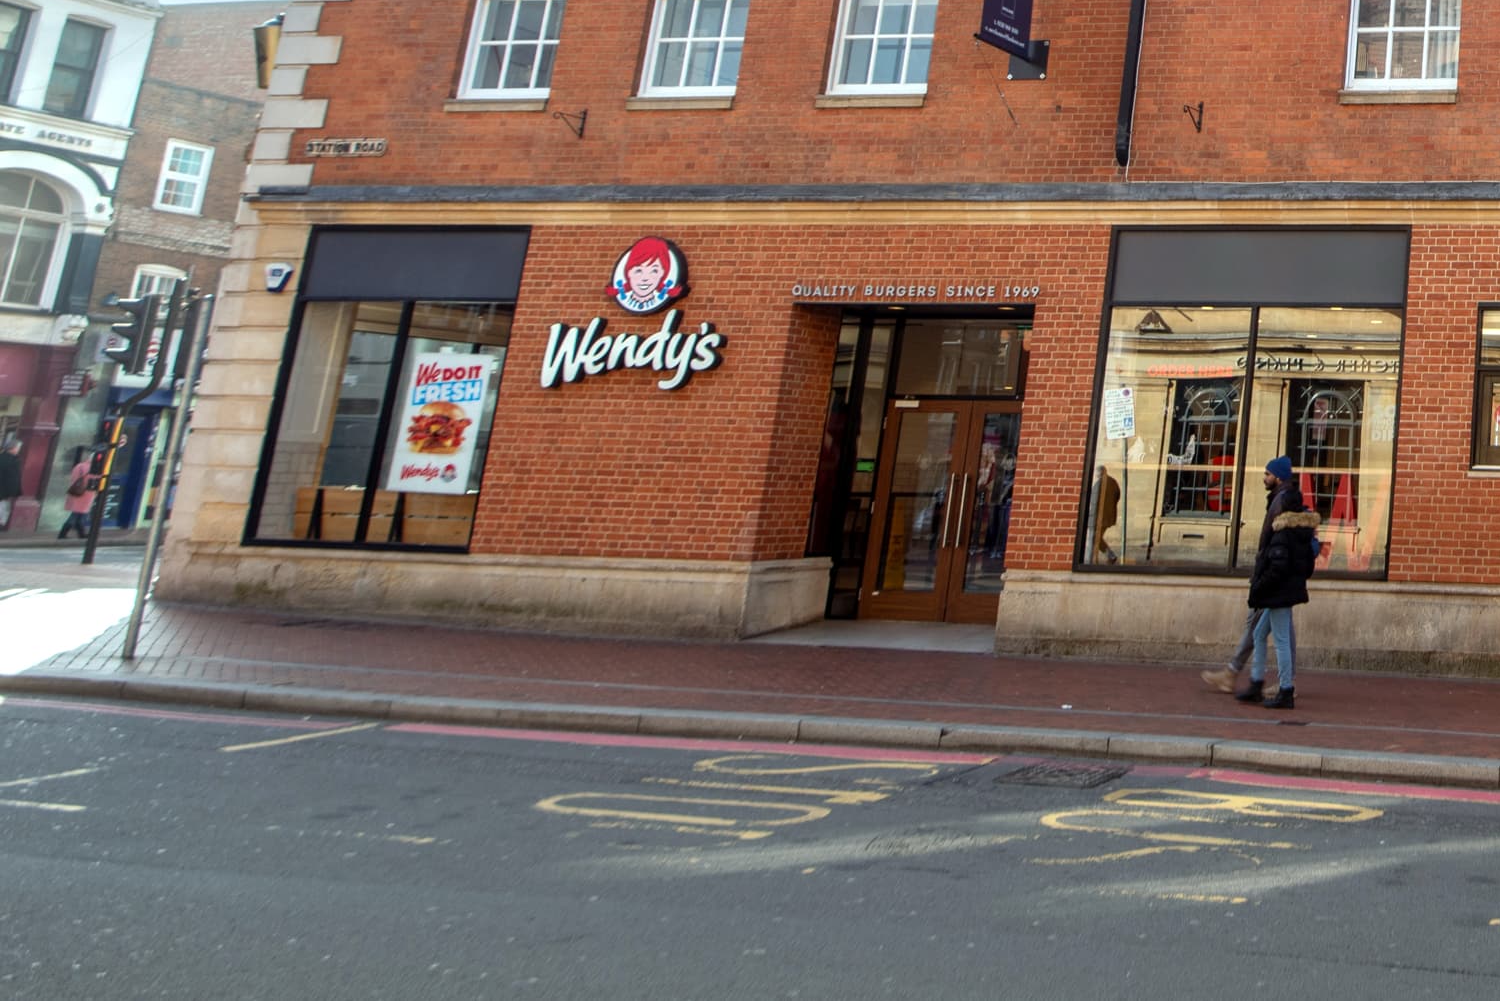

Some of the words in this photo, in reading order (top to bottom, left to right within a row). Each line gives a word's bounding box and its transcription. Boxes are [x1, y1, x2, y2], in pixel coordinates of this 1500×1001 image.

[36, 129, 92, 148] AGENTS
[355, 142, 385, 153] ROAD
[791, 284, 856, 297] QUALITY
[864, 285, 937, 297] BURGERS
[946, 285, 996, 297] SINCE
[1004, 286, 1040, 298] 1969
[540, 309, 721, 390] Wendy's
[416, 362, 440, 387] We
[442, 367, 467, 381] DO
[469, 365, 482, 380] IT
[415, 381, 482, 403] FRESH
